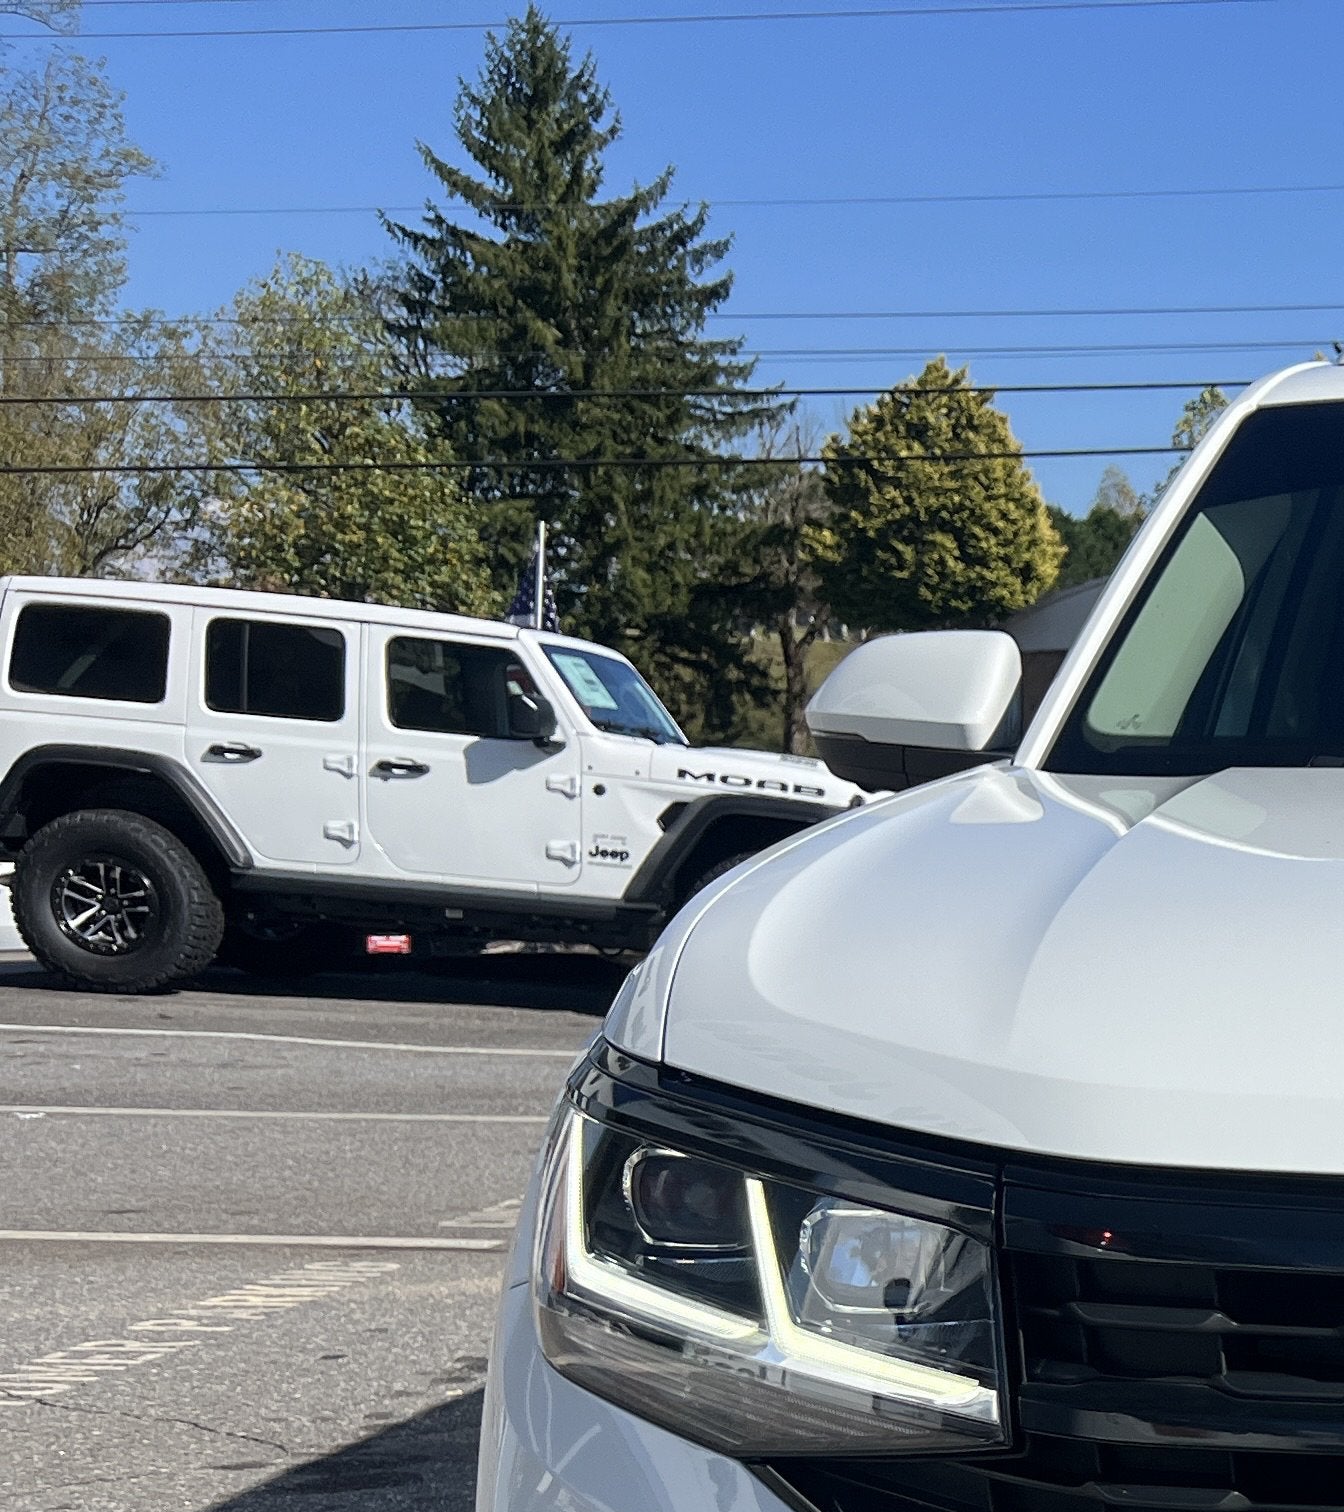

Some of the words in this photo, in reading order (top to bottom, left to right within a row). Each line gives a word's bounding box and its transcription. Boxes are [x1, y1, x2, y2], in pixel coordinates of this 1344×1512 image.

[677, 768, 826, 797] MOAB
[588, 845, 630, 862] Jeep
[0, 1341, 202, 1407] OMER
